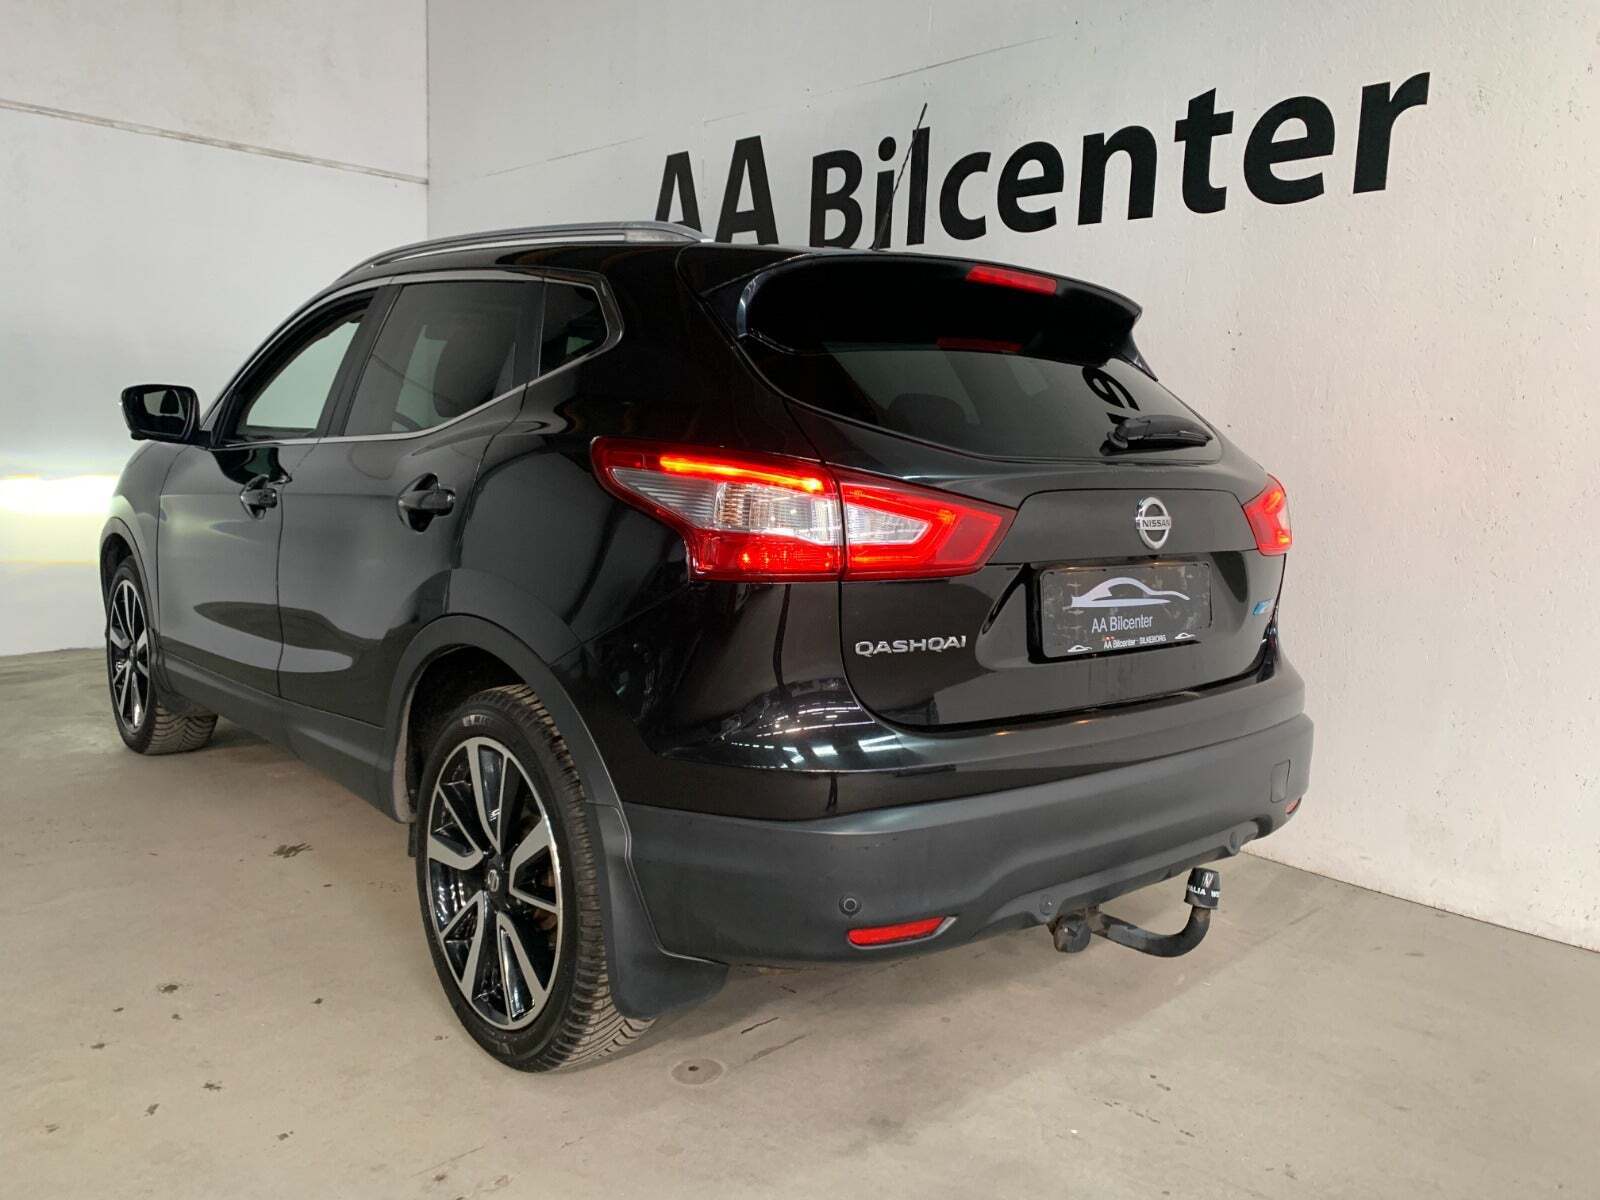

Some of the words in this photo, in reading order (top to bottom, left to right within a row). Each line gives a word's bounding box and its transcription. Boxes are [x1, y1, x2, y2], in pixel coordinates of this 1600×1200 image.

[654, 135, 780, 246] AA
[808, 71, 1431, 251] Bilcenter
[1142, 519, 1170, 528] NISSAN
[1091, 617, 1108, 634] AA
[1109, 614, 1153, 632] Bilcenter
[855, 635, 966, 657] QASHQAI
